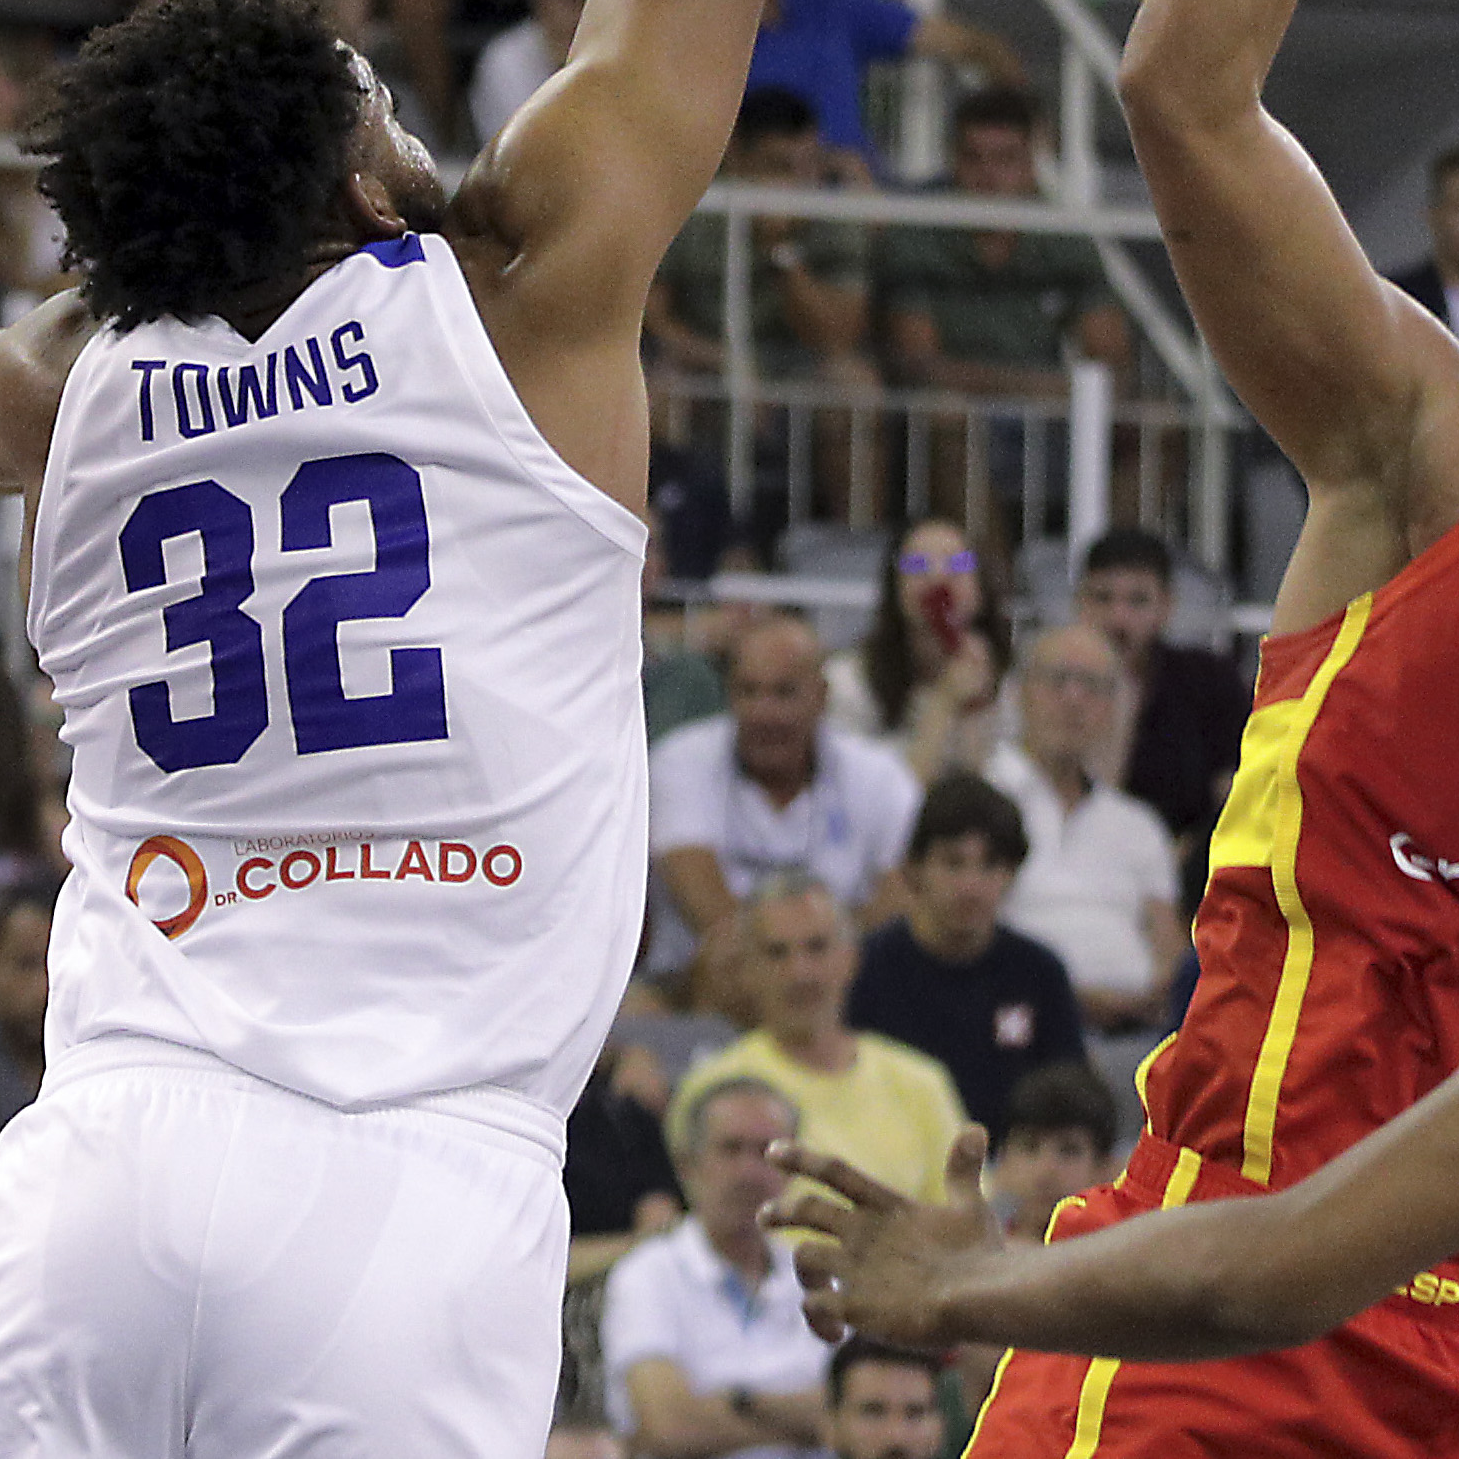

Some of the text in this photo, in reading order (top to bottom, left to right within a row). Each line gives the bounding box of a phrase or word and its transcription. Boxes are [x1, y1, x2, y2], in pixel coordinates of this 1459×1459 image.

[130, 319, 380, 442] TOWNS
[117, 451, 450, 774] 32
[235, 840, 523, 900] COLLADO
